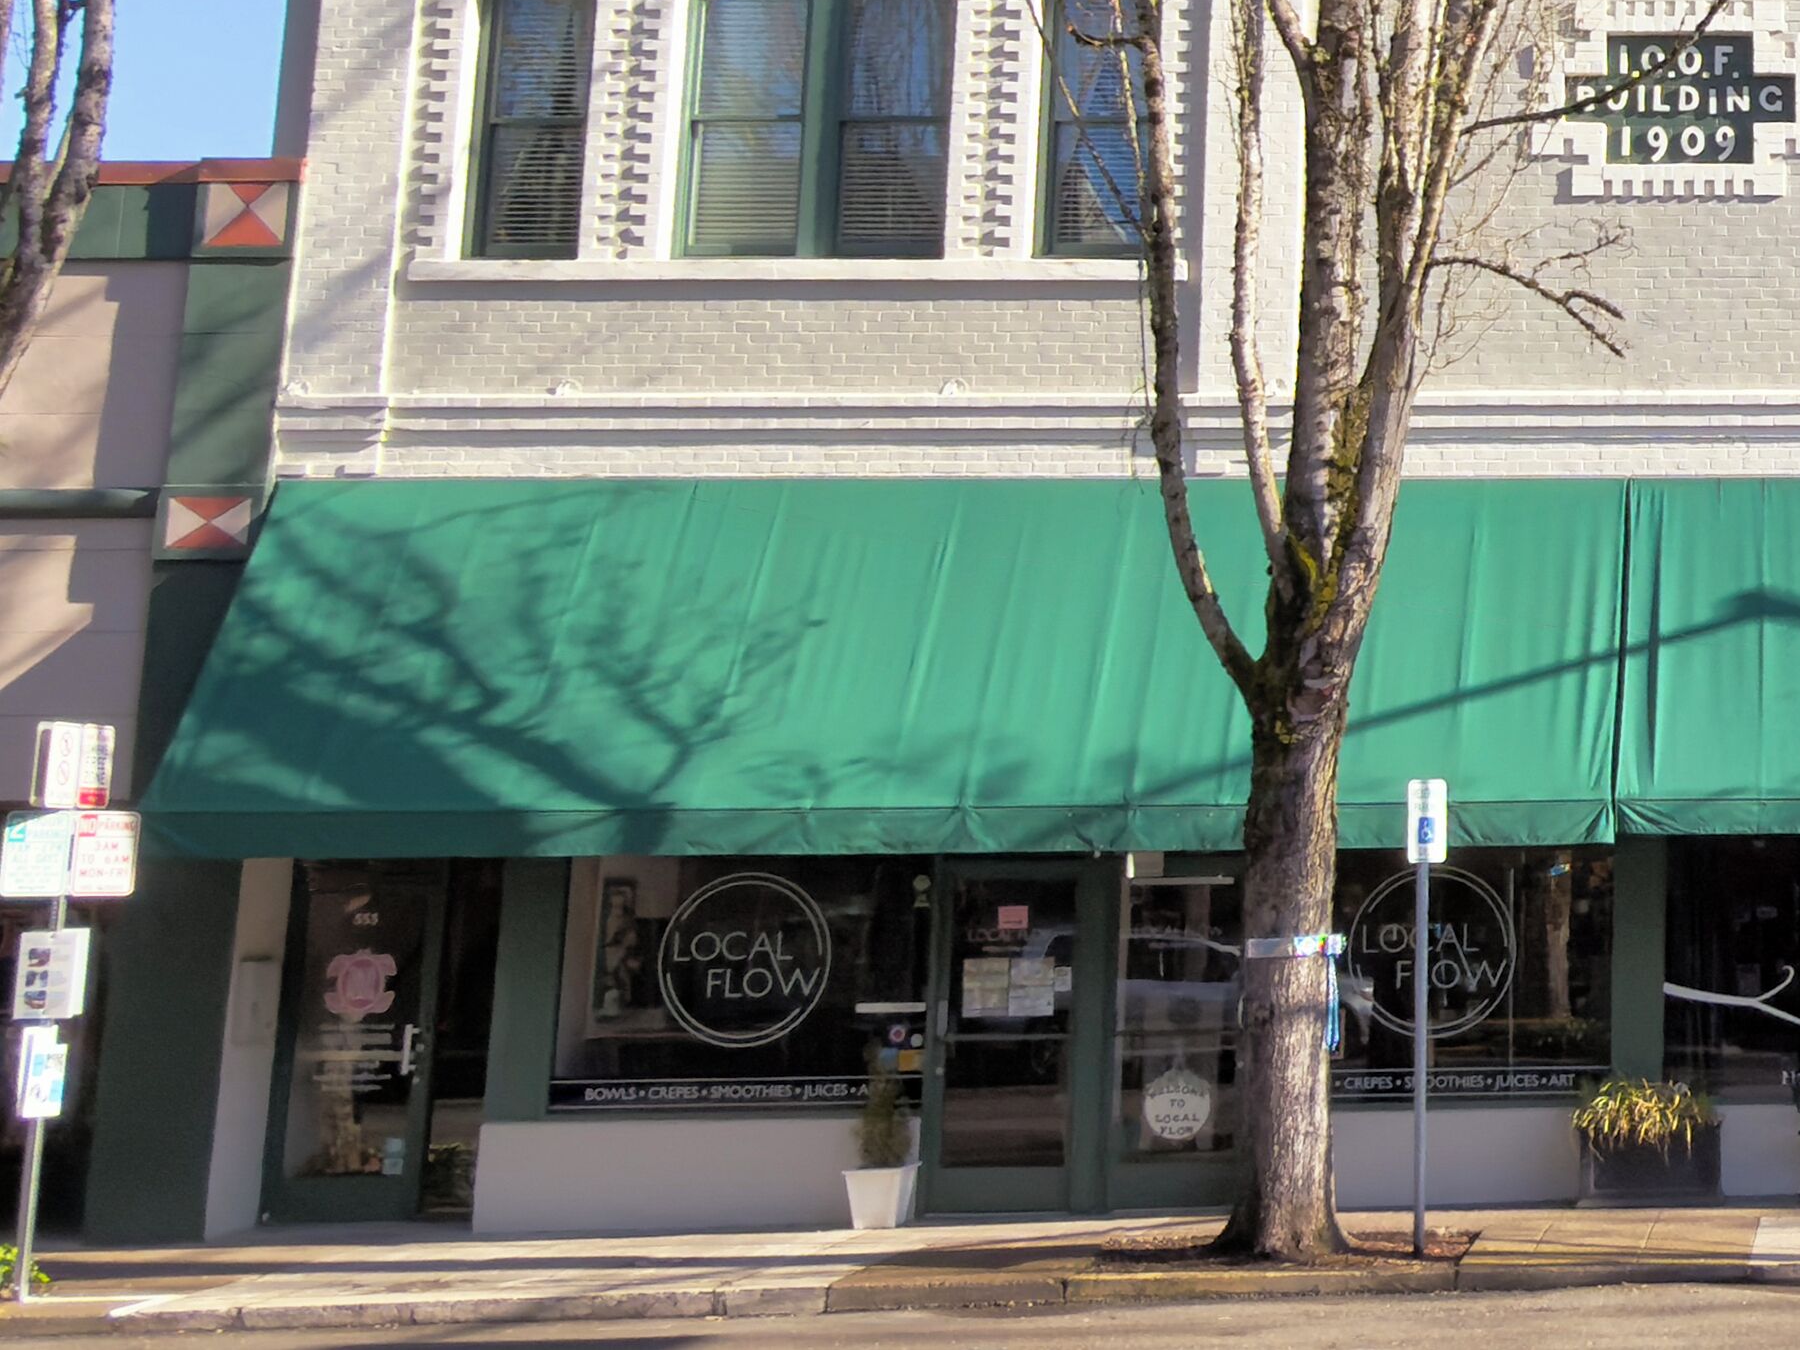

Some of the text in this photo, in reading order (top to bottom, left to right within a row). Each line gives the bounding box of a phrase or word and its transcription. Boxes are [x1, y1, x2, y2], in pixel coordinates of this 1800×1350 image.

[1576, 84, 1784, 115] BUILDING
[1621, 125, 1736, 163] 1909
[673, 930, 794, 963] LOCAL
[706, 966, 821, 999] FLOW
[1396, 959, 1508, 991] FOW
[584, 1086, 638, 1101] BOWLS
[649, 1085, 699, 1099] CREPES
[709, 1084, 794, 1099] SMOOTHIES
[803, 1083, 849, 1099] JUICES
[1343, 1073, 1577, 1091] CREPES SOOTHIES JUICES ART
[1154, 1113, 1200, 1124] LOCAL
[1169, 1098, 1186, 1108] TO
